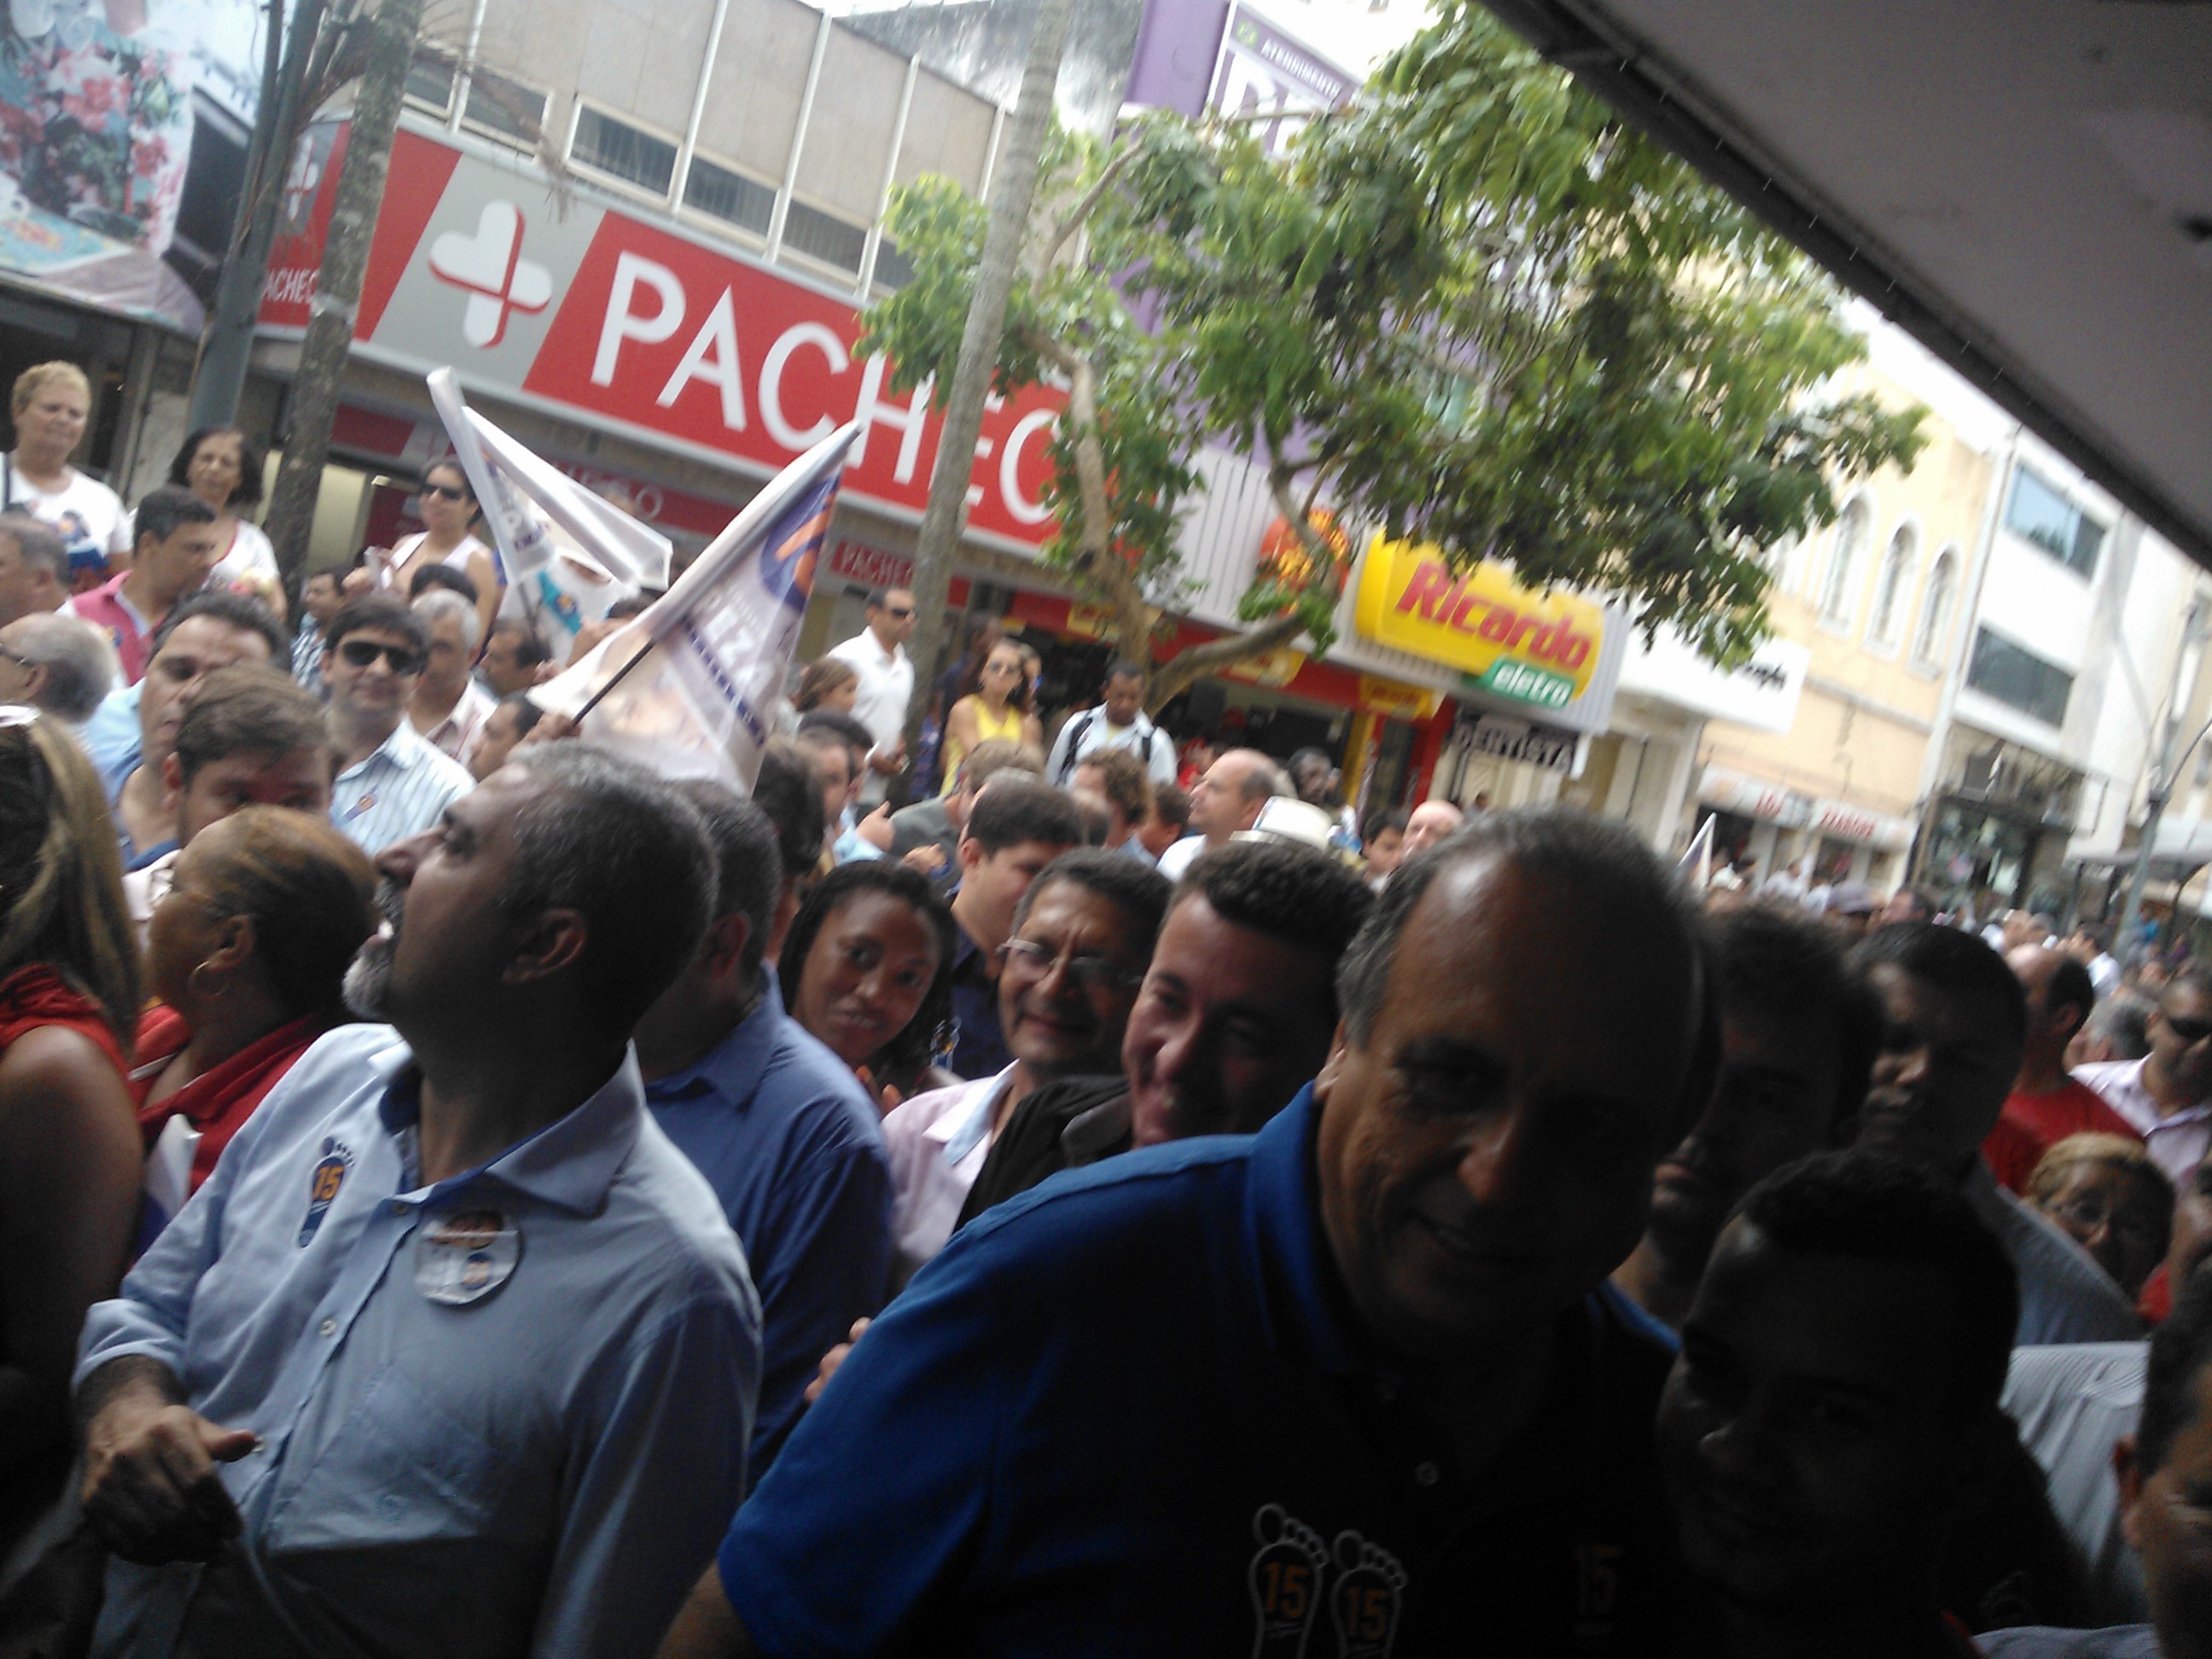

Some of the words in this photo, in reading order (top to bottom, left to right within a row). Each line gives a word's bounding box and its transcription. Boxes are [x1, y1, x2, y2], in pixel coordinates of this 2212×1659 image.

[590, 250, 1062, 525] PACHC
[1394, 556, 1592, 670] Ricardo
[1492, 661, 1574, 708] eletro
[312, 1165, 344, 1202] 15
[1264, 1562, 1311, 1618] 15
[1346, 1586, 1389, 1641] 15
